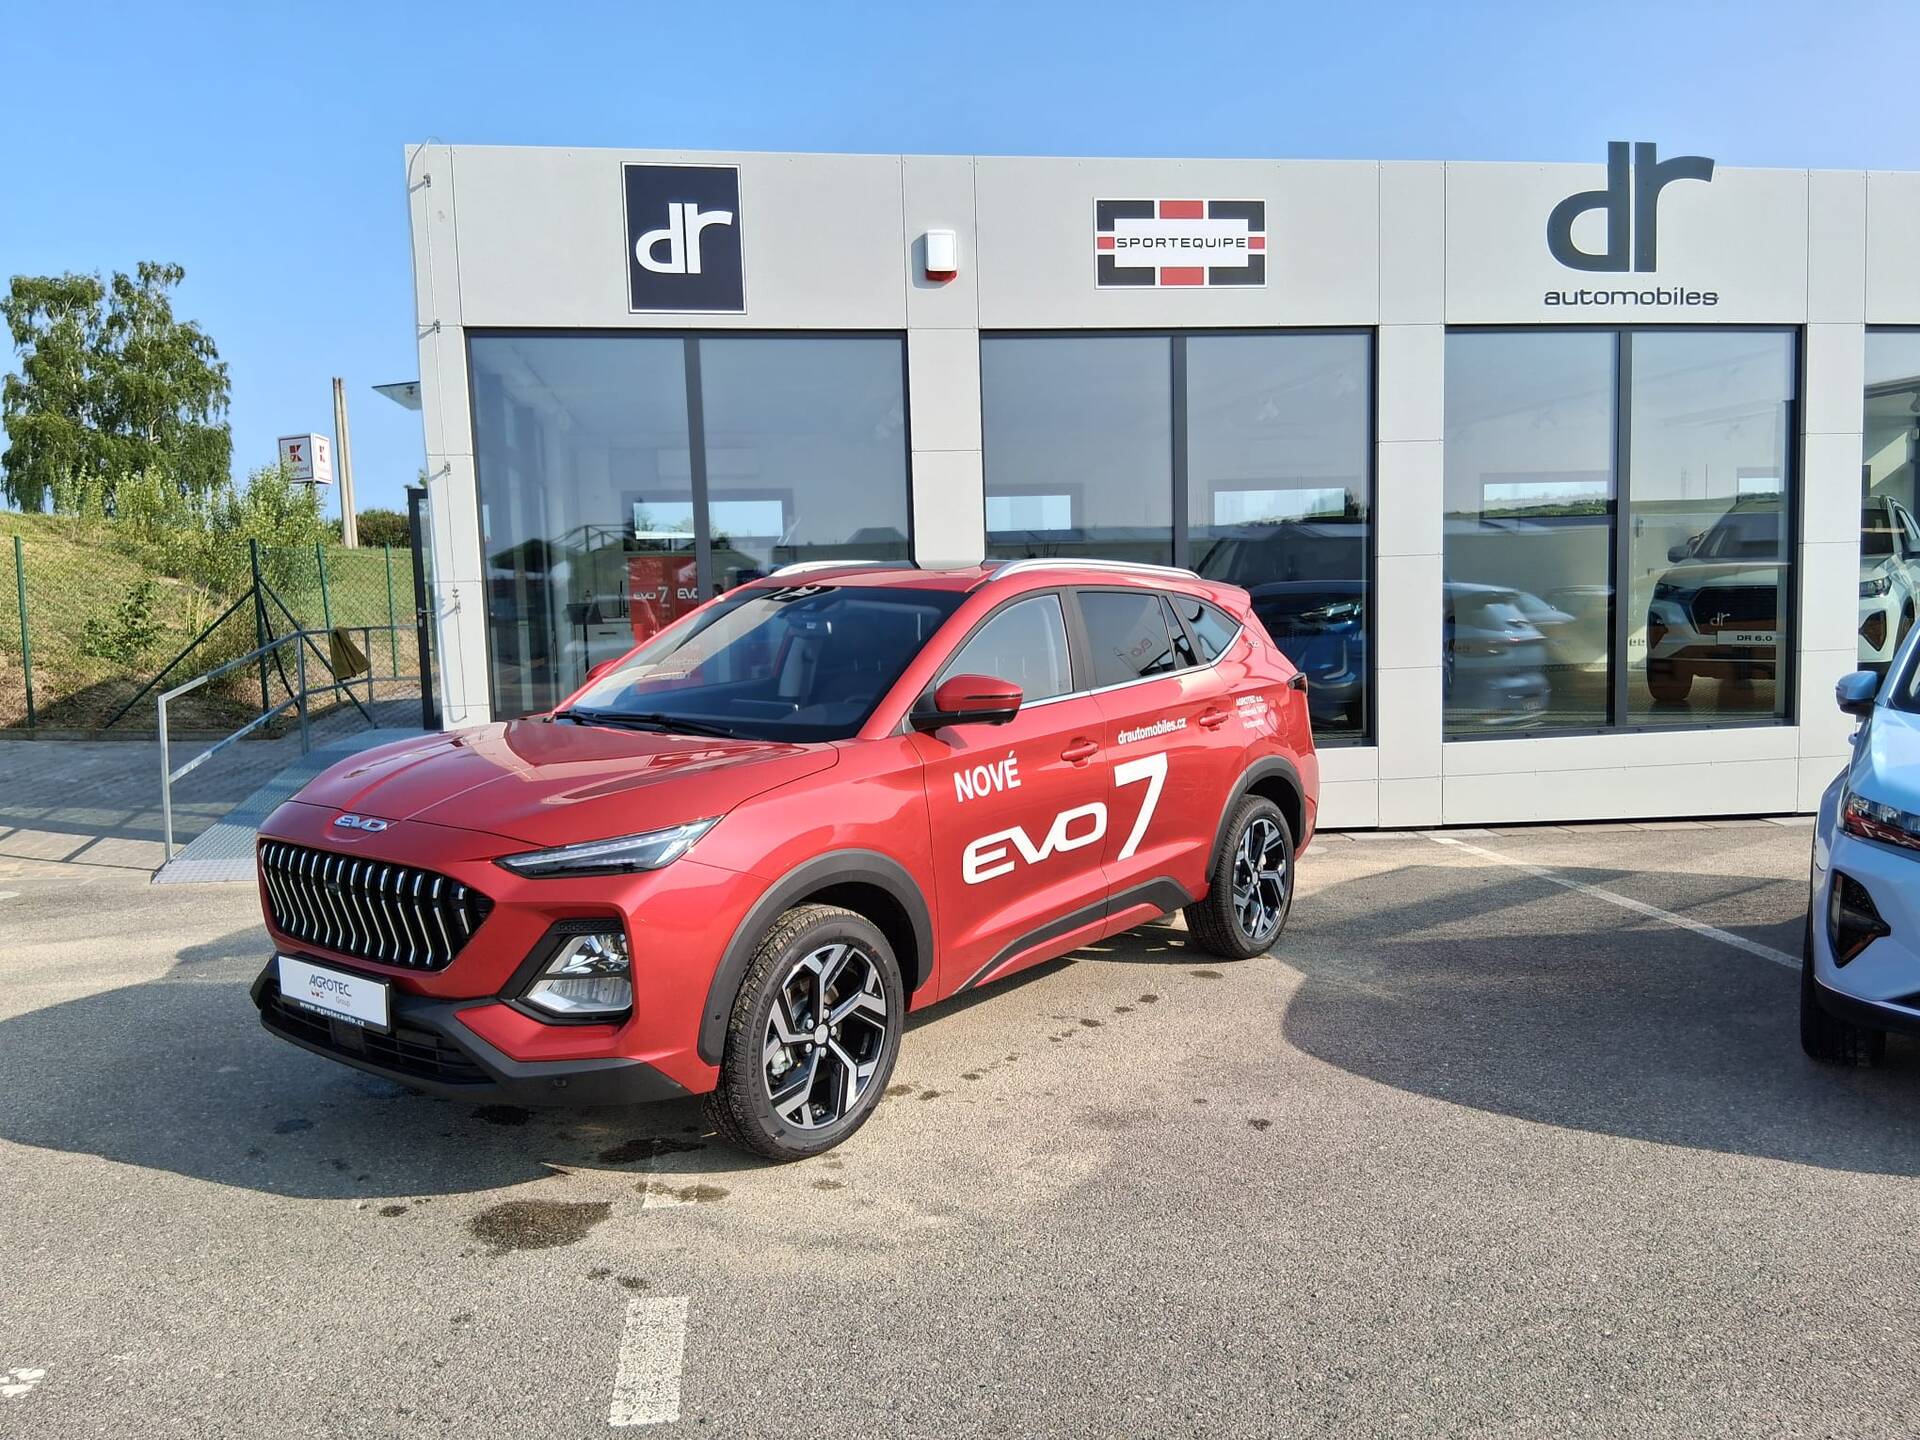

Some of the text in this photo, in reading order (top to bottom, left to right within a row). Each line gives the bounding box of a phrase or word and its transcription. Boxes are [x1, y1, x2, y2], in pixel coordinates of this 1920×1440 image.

[1547, 141, 1715, 272] dr
[635, 202, 733, 274] dr
[1116, 237, 1246, 249] SPORTEQUIPE
[1544, 287, 1718, 305] automobiles
[1117, 717, 1187, 744] drautomobiles.cz
[953, 750, 1021, 802] NOVÉ
[334, 815, 388, 831] EVO
[962, 752, 1168, 885] EVO 7
[309, 974, 352, 997] AGROTEC
